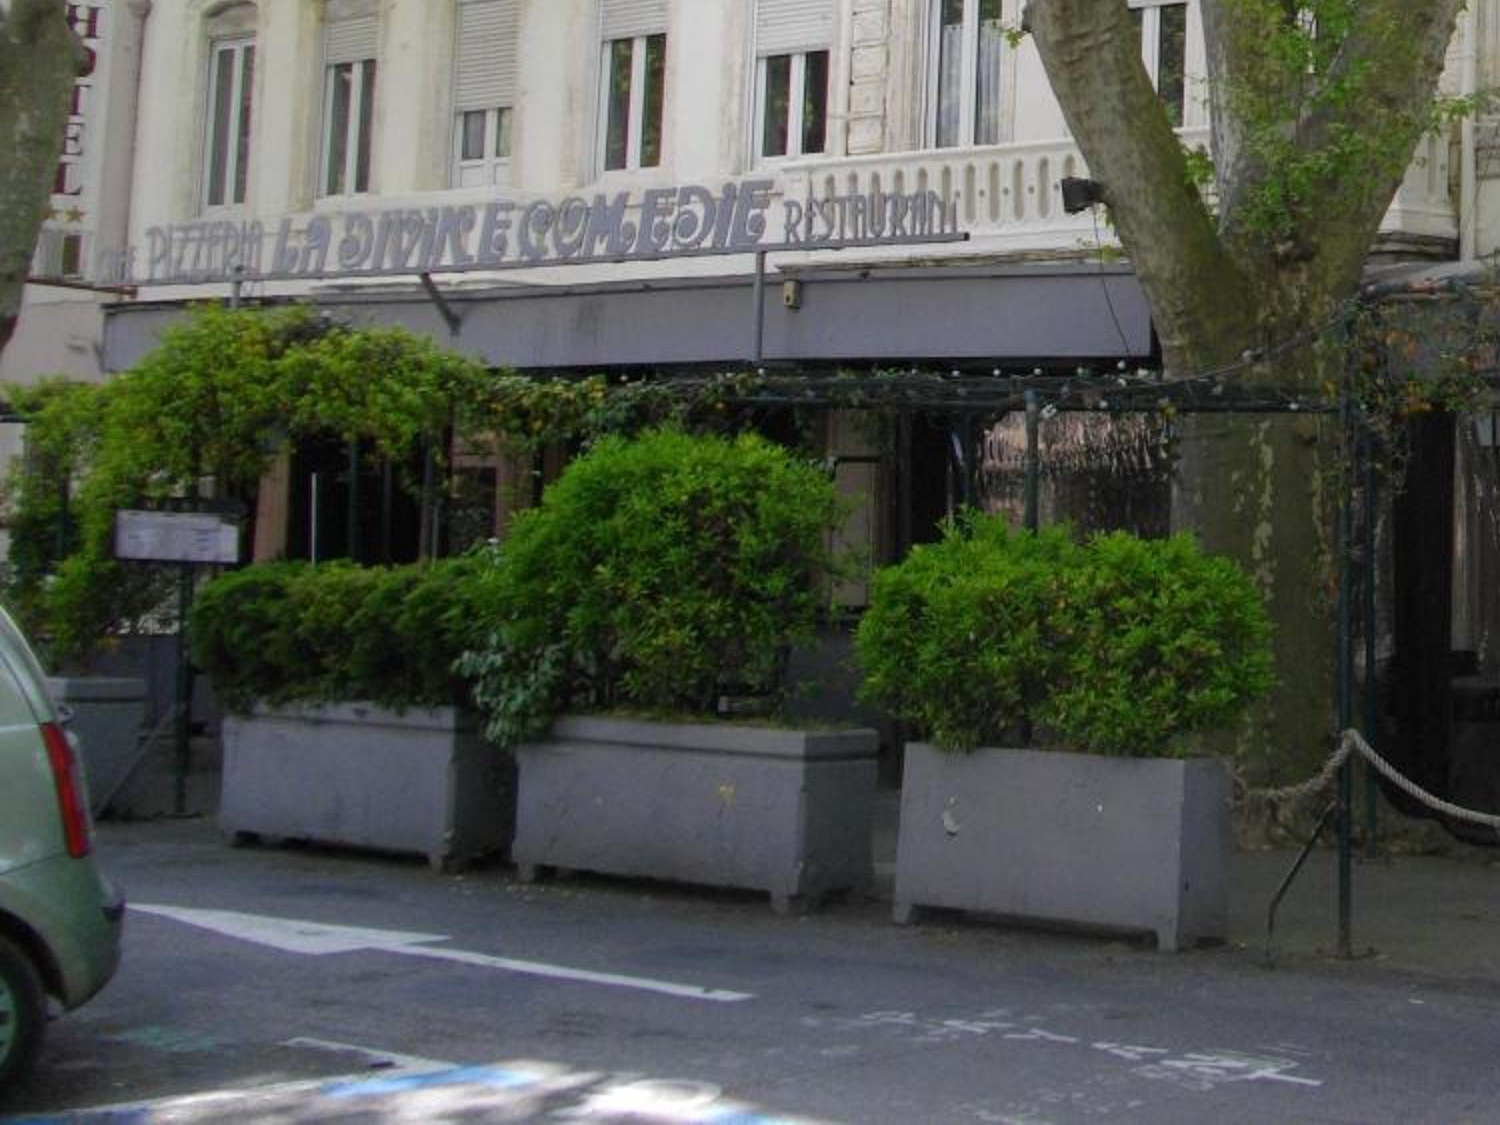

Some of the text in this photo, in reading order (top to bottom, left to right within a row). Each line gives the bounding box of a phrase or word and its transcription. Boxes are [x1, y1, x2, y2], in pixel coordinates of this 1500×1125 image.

[145, 218, 263, 283] PIZZERIA
[273, 215, 332, 274] LA
[337, 197, 514, 271] DIVINE
[517, 179, 773, 261] COMEDIE
